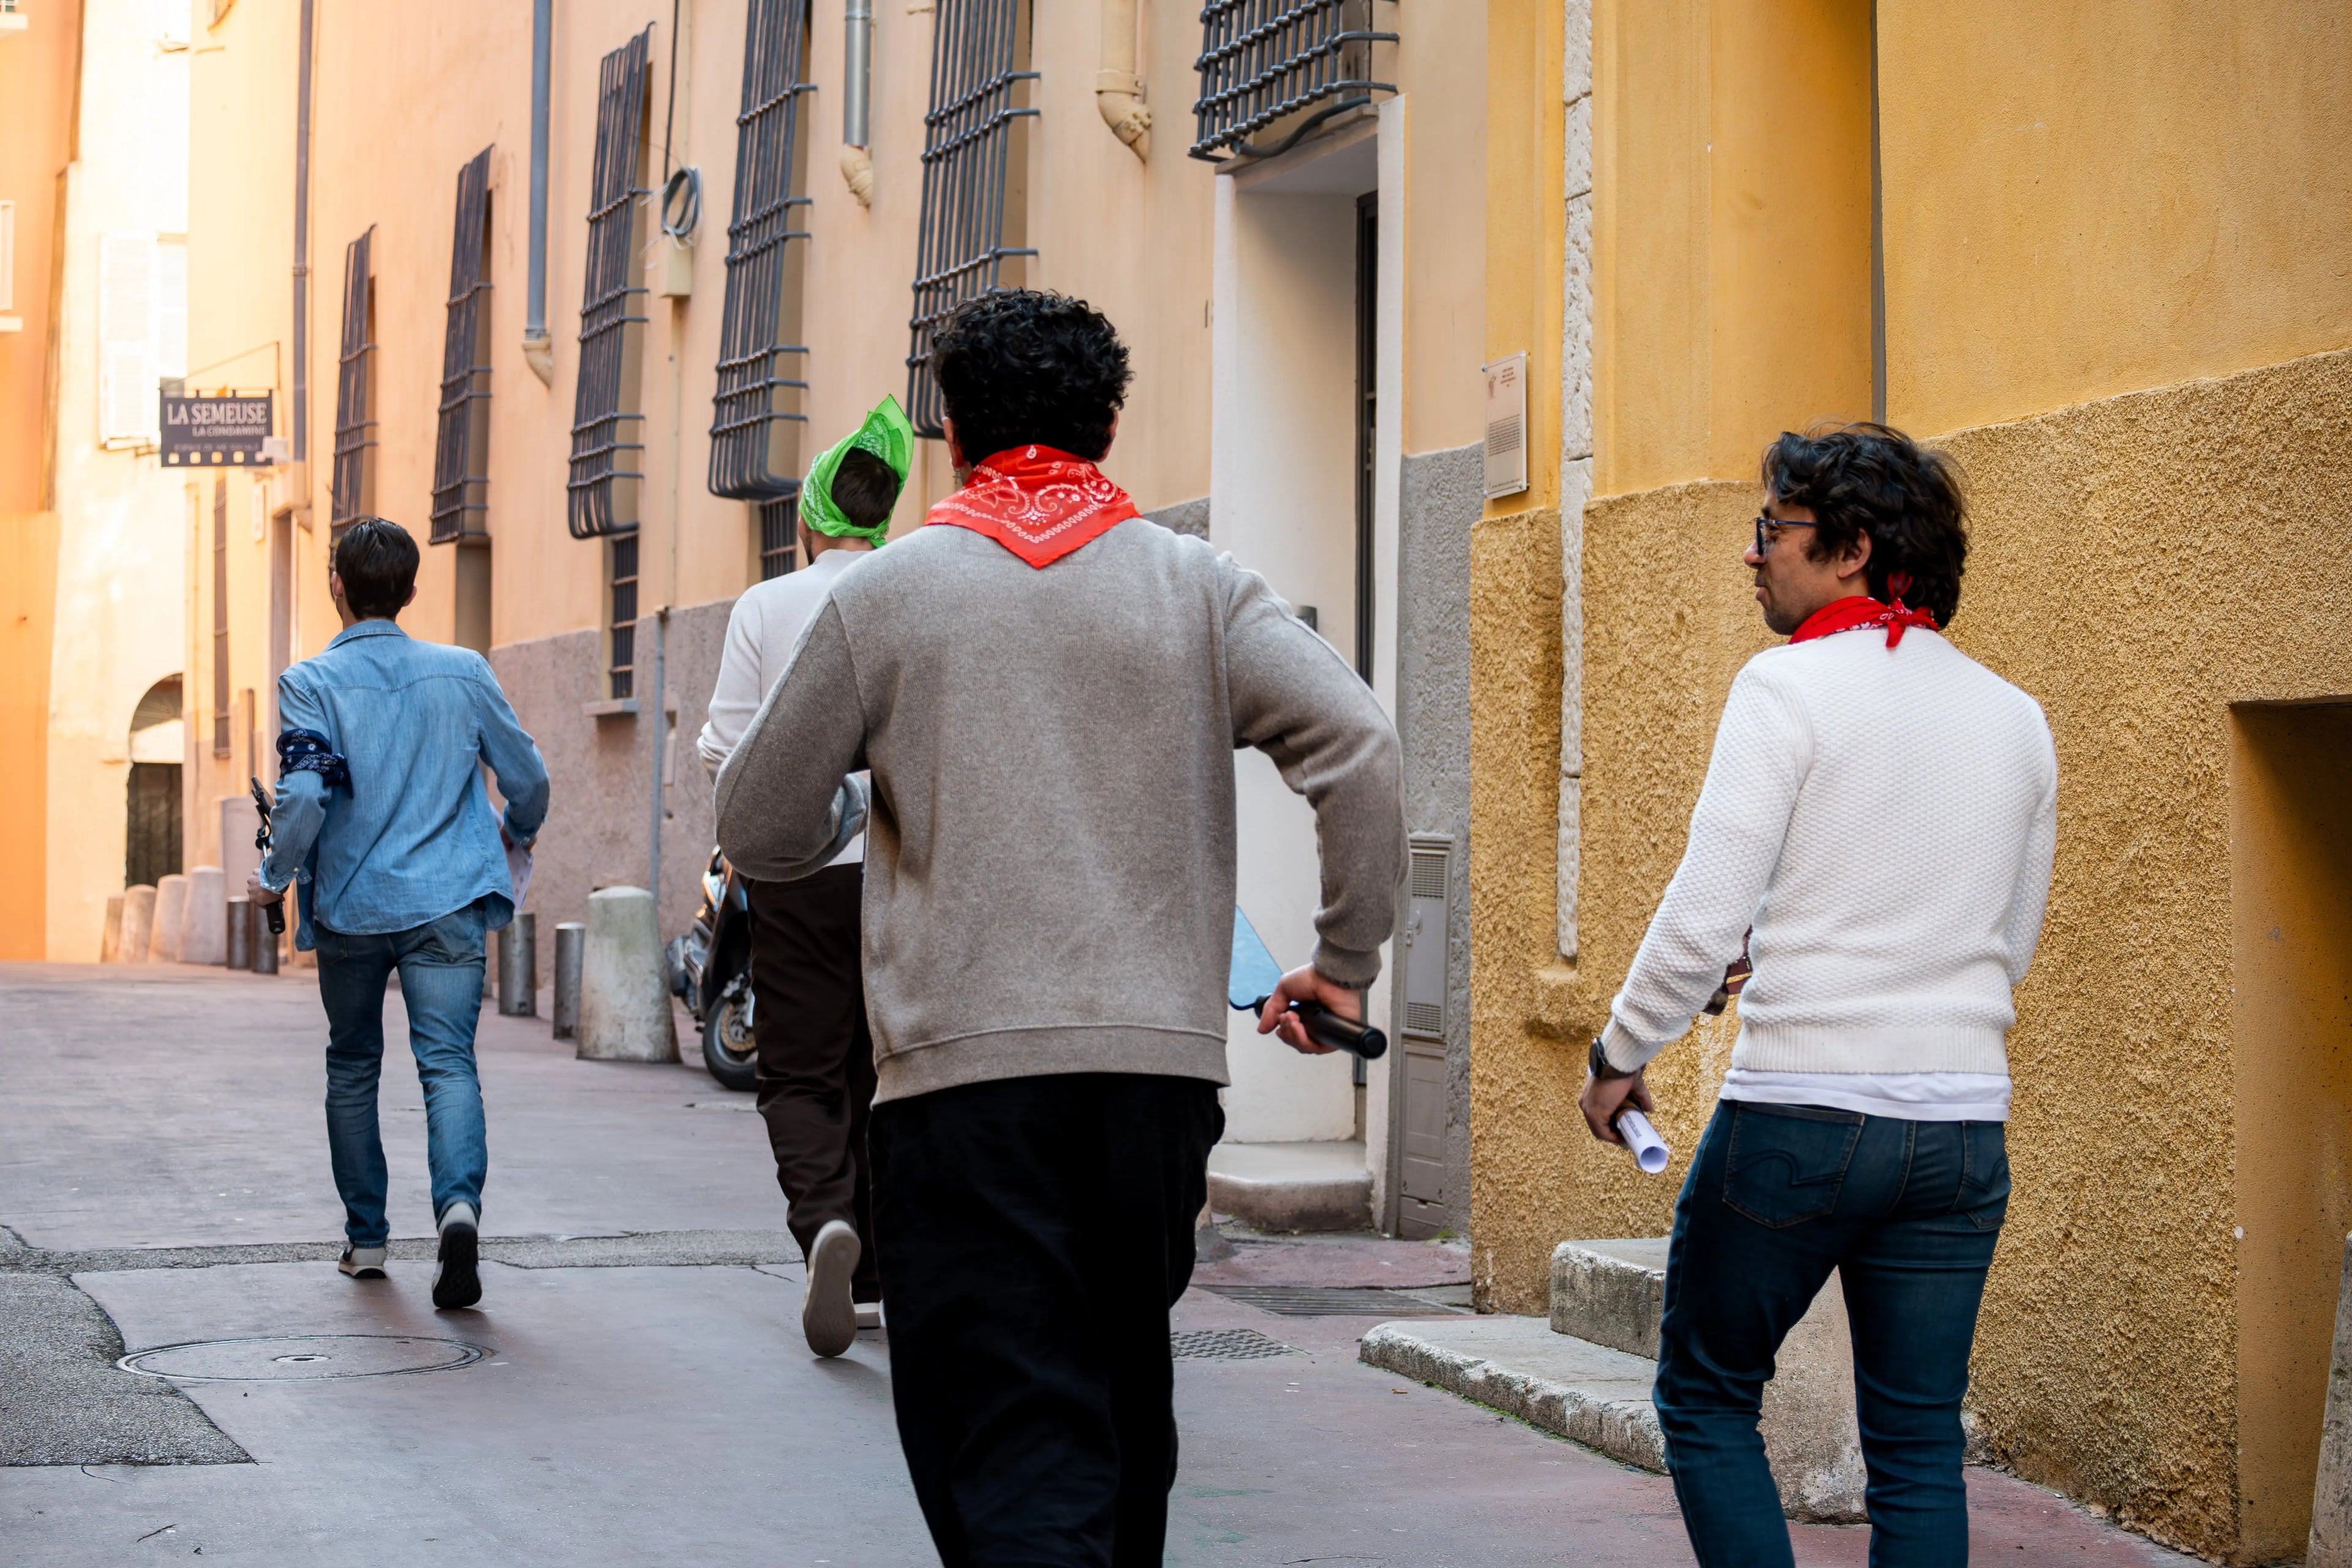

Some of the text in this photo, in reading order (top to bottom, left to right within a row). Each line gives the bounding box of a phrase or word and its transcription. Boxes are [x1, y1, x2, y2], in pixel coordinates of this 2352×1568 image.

[167, 402, 267, 425] LA SEMEUSE
[192, 425, 206, 437] LA
